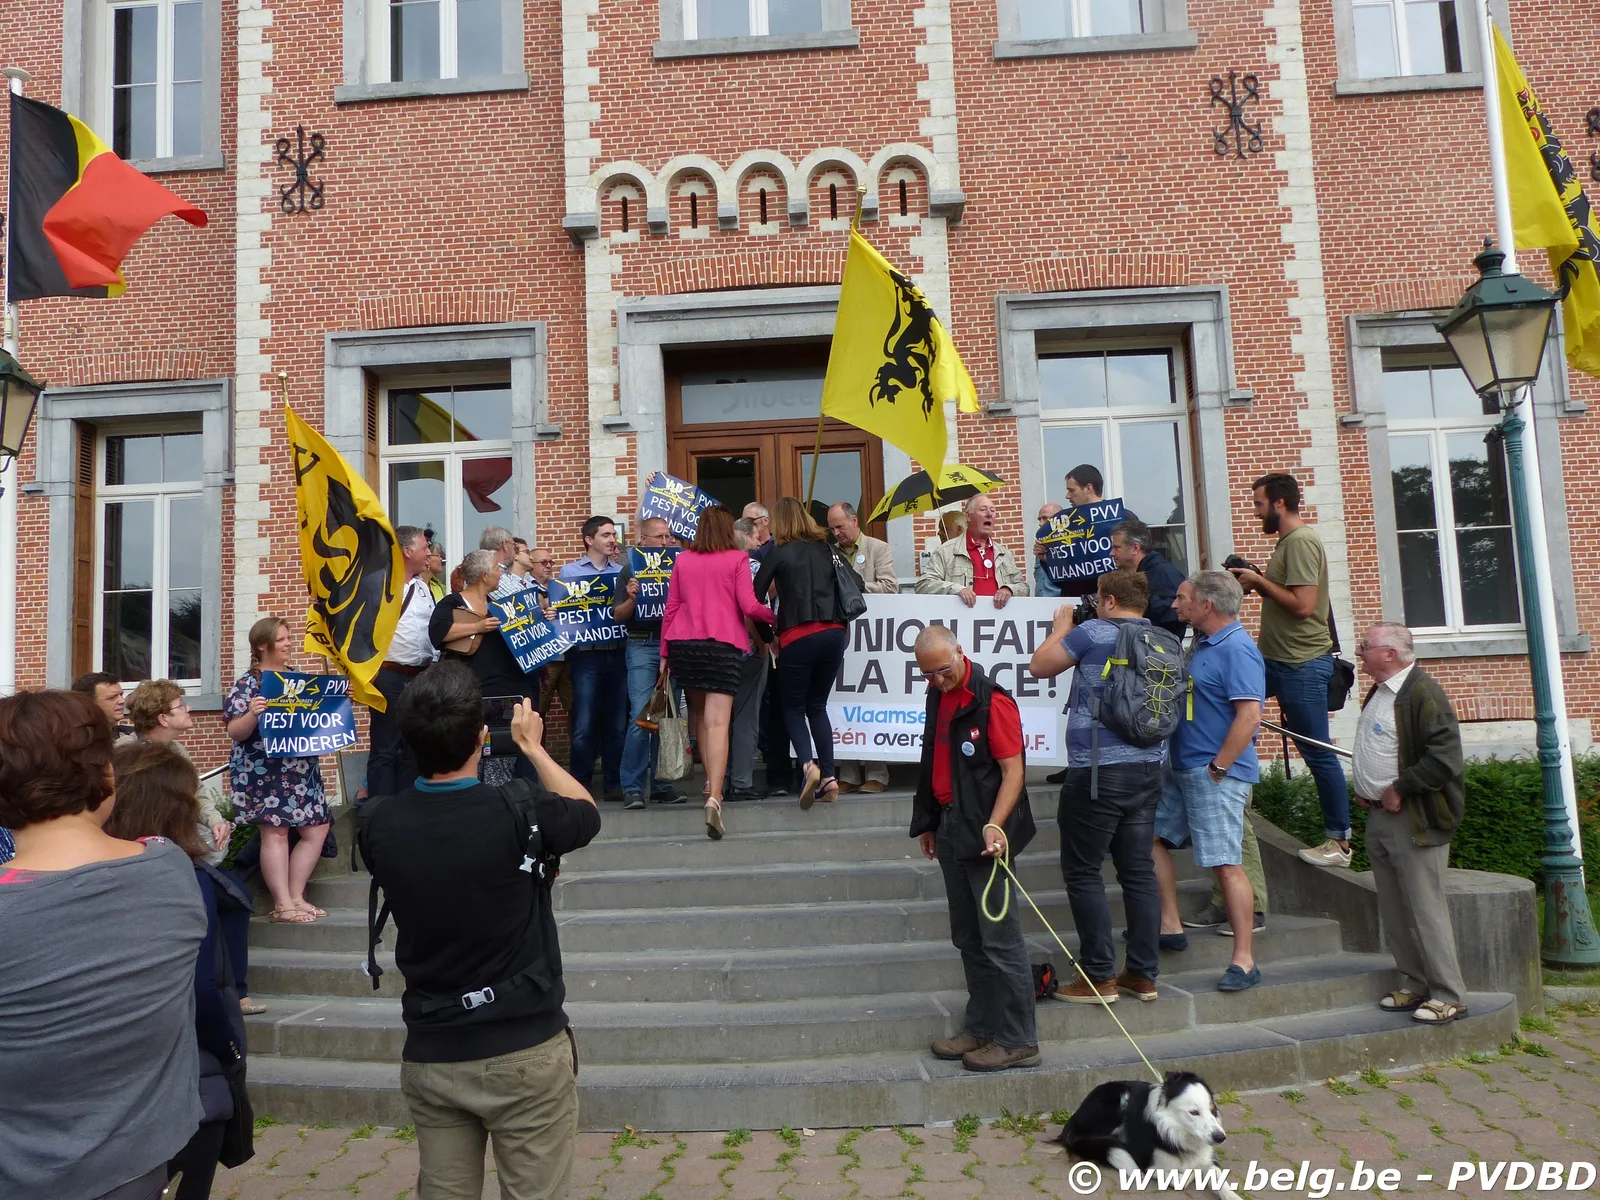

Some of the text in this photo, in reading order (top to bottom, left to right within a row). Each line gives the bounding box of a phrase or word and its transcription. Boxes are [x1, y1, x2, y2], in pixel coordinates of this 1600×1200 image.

[650, 496, 679, 514] PEST
[1090, 503, 1119, 521] PVV
[1049, 536, 1113, 560] PEST VOO
[1049, 557, 1118, 579] VLAANDER
[641, 582, 665, 597] PEST
[523, 591, 537, 608] PVV
[558, 608, 593, 625] PEST
[637, 603, 666, 618] VLAA
[510, 630, 530, 649] PEST
[527, 621, 551, 641] VOOR
[516, 633, 570, 671] VLAANDEREN
[835, 658, 889, 694] LA
[324, 680, 350, 695] PVV
[264, 712, 344, 729] PEST VOOR
